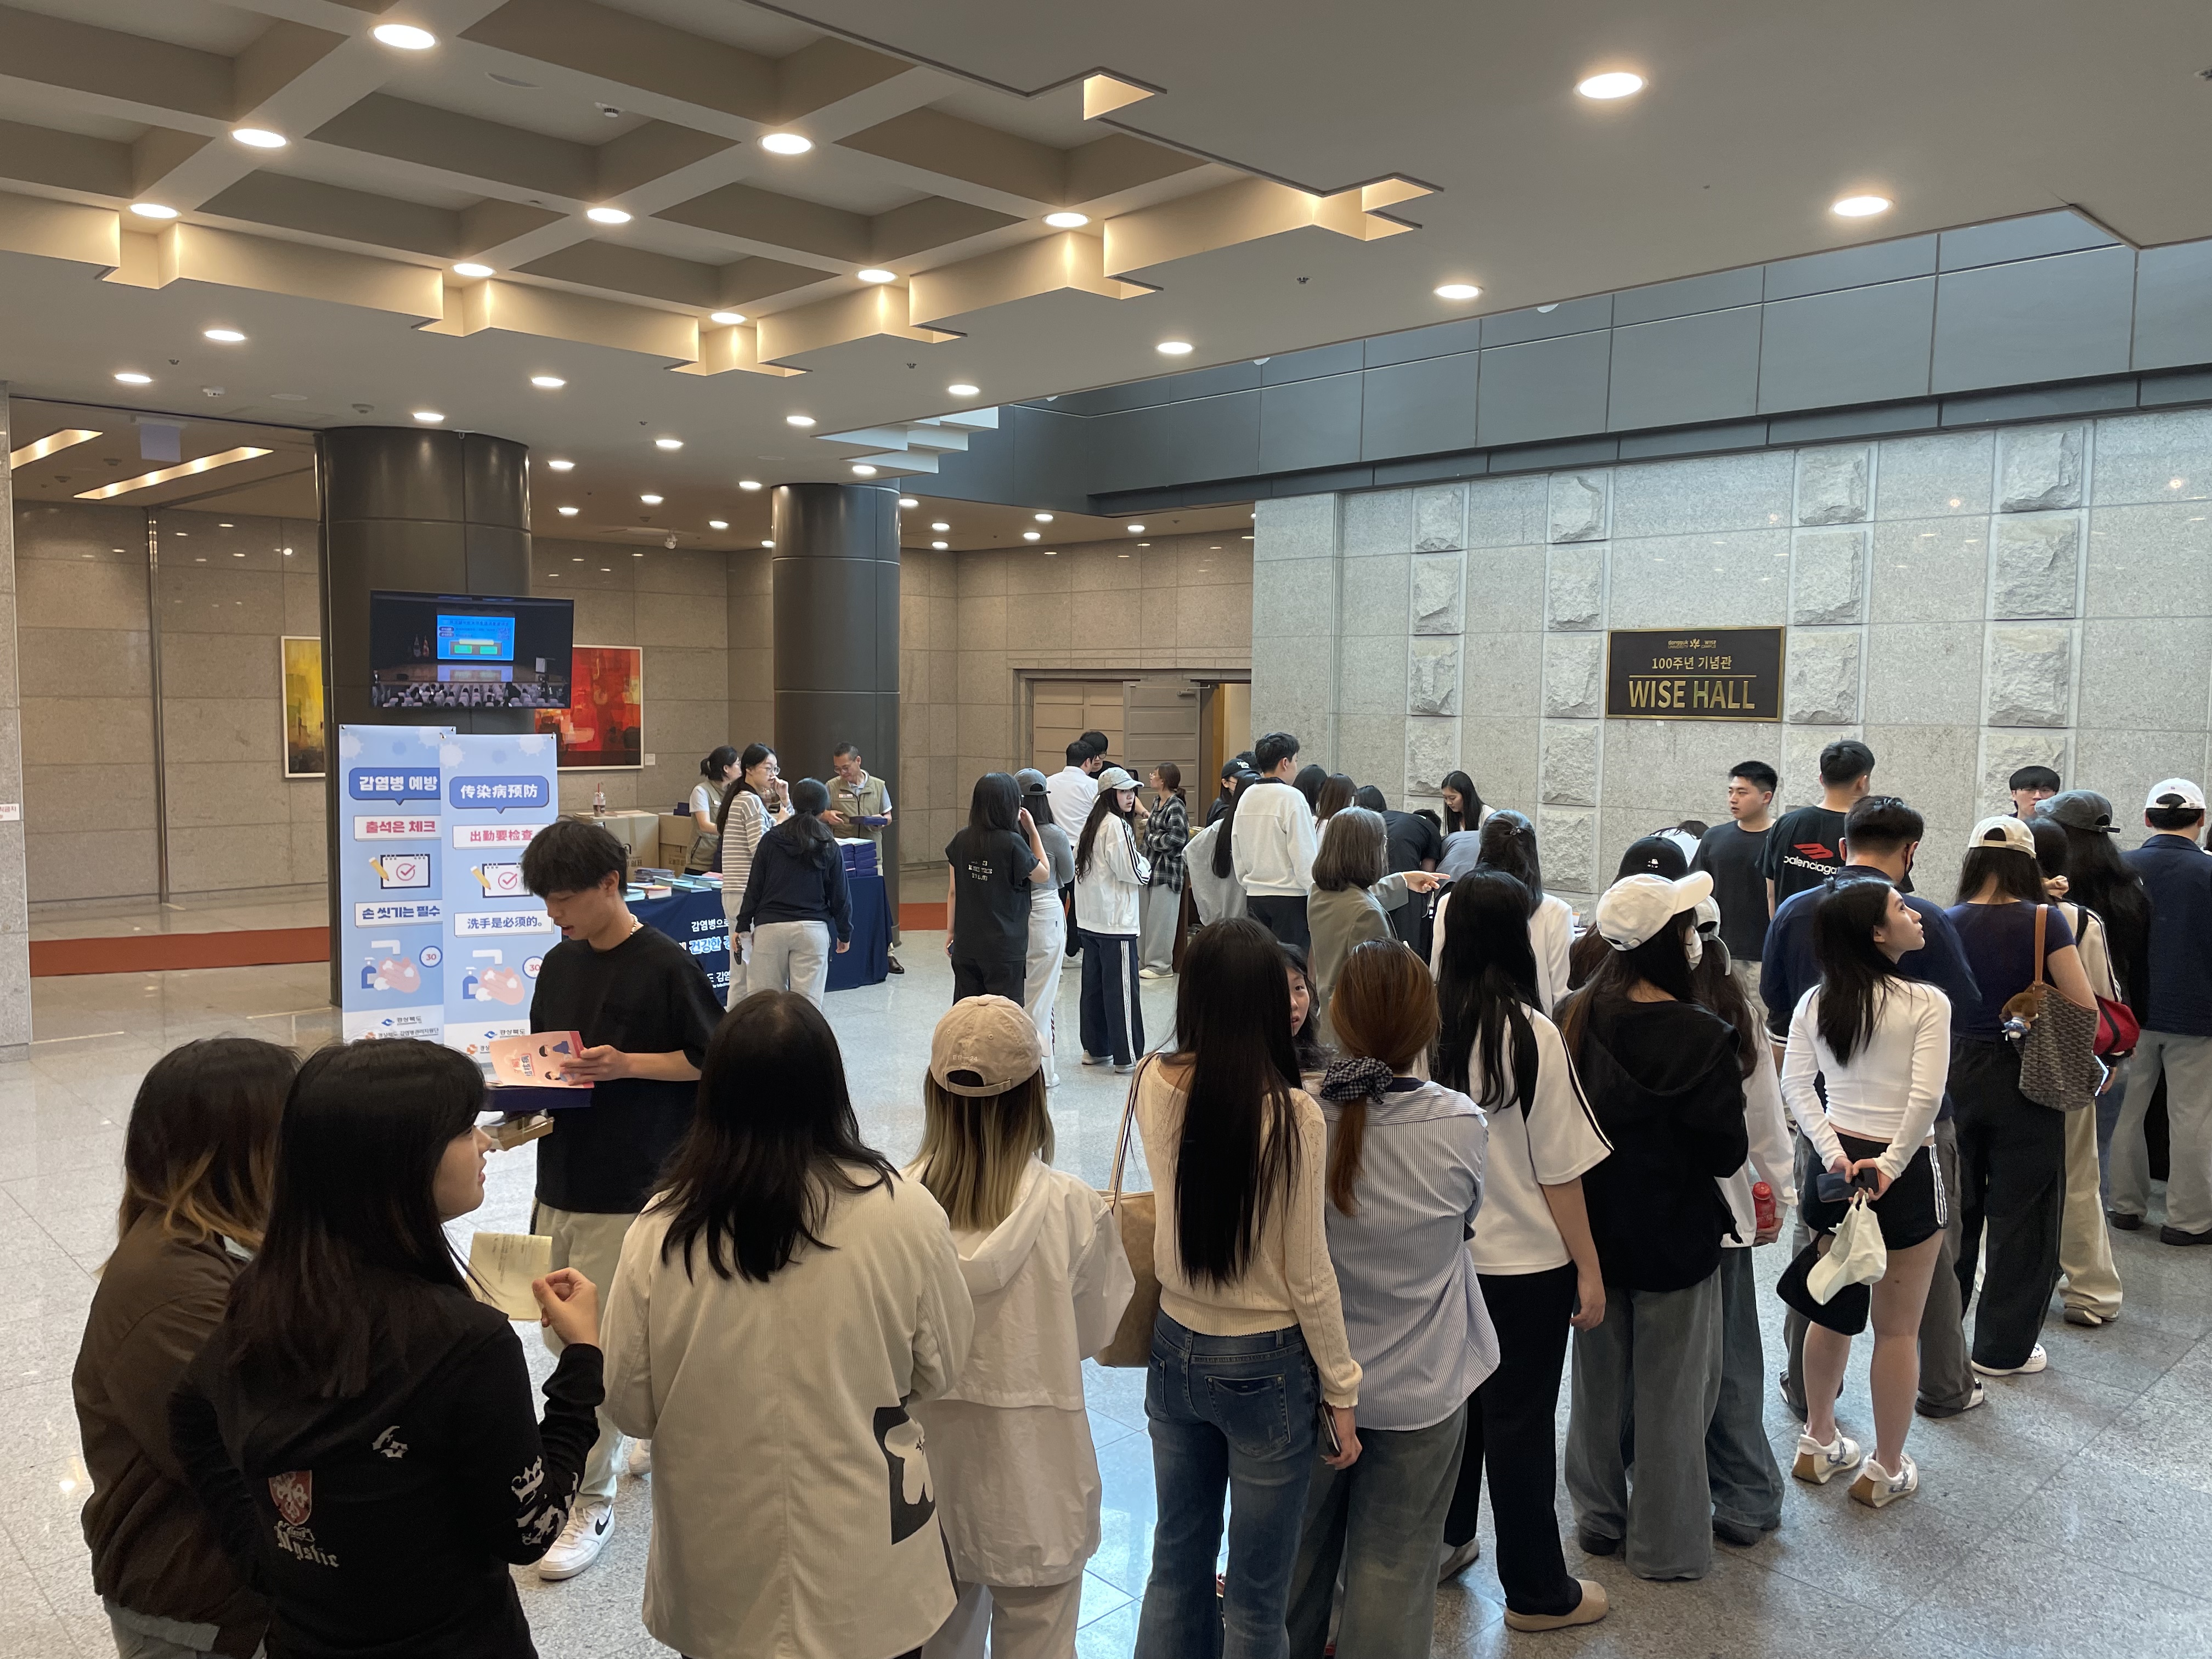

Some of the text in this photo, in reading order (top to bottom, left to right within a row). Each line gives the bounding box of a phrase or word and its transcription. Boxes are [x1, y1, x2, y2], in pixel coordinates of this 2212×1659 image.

[1652, 656, 1732, 670] 100주년 기념관
[1629, 680, 1755, 709] WISE HALL
[359, 776, 438, 791] 감염병 예방
[460, 784, 538, 799] 传染病预防
[366, 821, 436, 833] 출석은 체크
[363, 906, 440, 919] 손 씻기는 필수
[467, 916, 542, 929] 洗手是必须的。
[689, 936, 721, 954] 건강한
